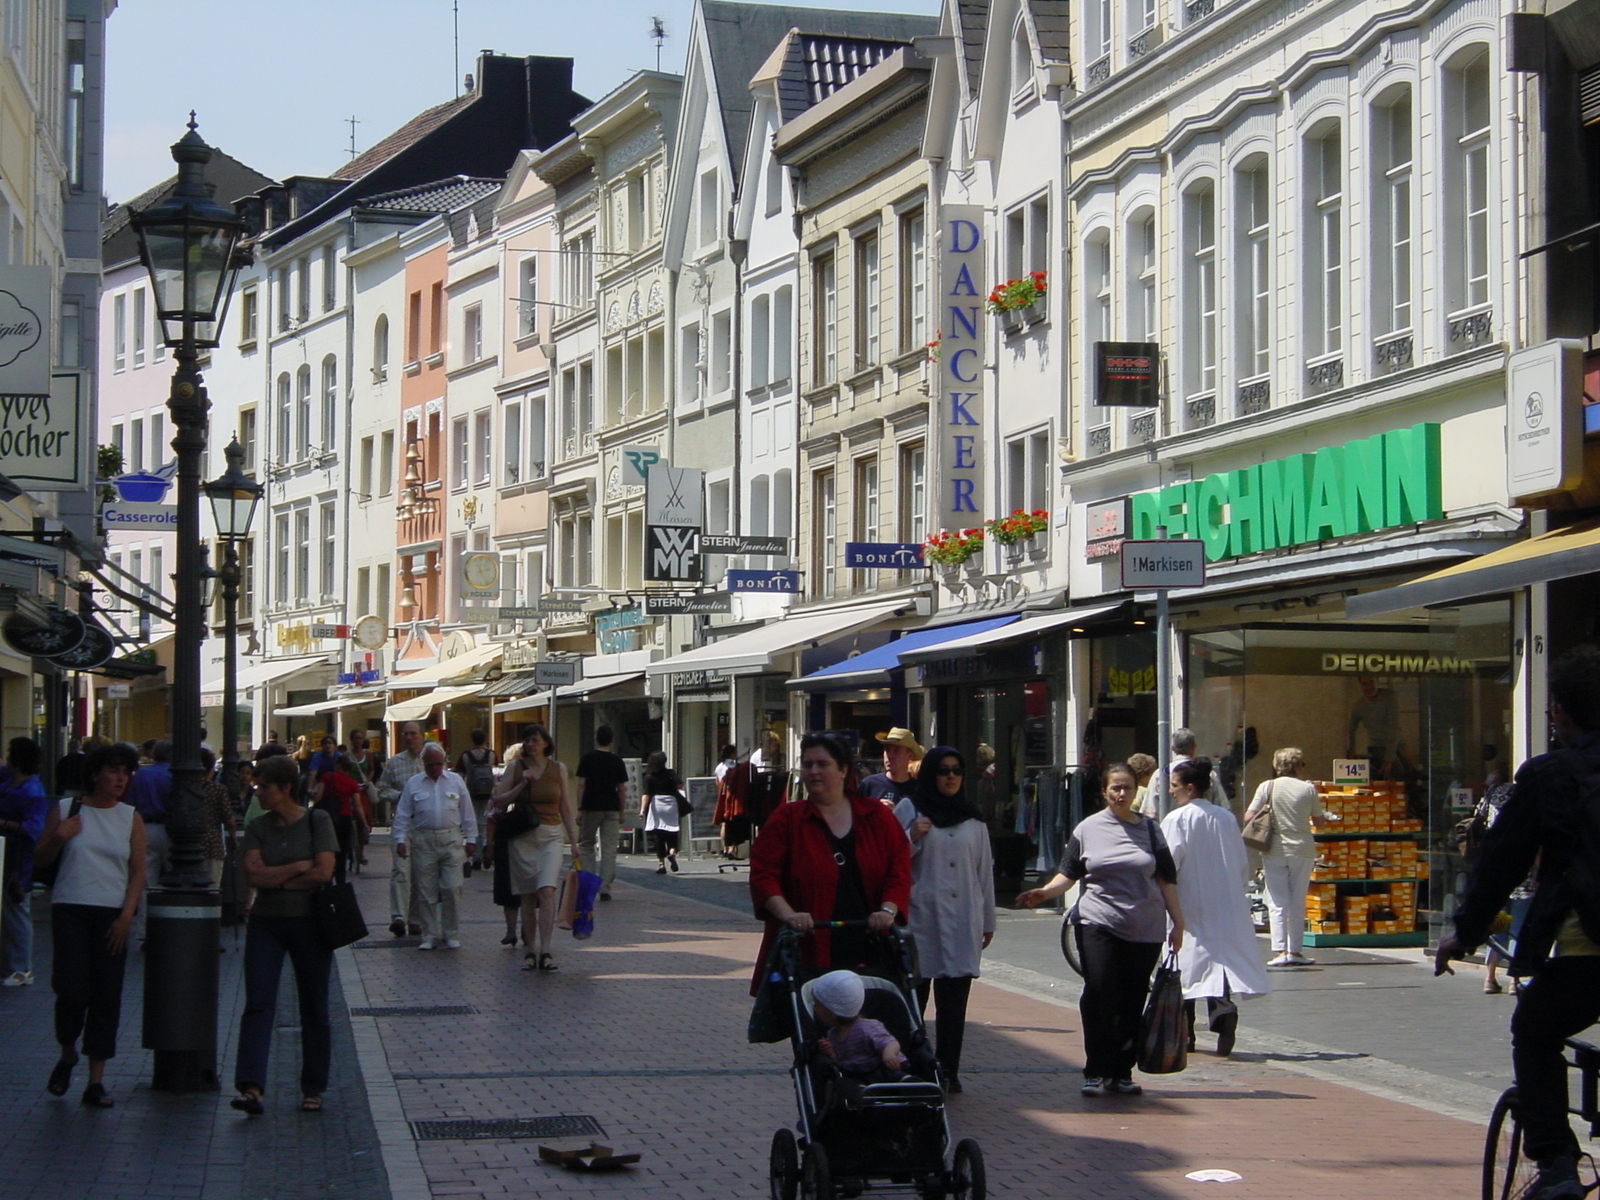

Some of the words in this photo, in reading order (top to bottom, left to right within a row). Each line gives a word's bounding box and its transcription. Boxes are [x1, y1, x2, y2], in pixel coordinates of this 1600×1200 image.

[948, 219, 981, 513] DANCKER
[0, 423, 71, 459] ocher
[1132, 421, 1444, 562] DEICHMANN
[104, 509, 178, 524] Casserole
[701, 536, 741, 547] STERN
[736, 541, 785, 553] Juwelier
[854, 545, 917, 566] BONITA
[736, 571, 792, 591] BONITA
[501, 609, 526, 617] Street
[540, 601, 566, 609] Street
[649, 598, 686, 608] STERN
[682, 601, 728, 613] Juwelier
[1321, 653, 1476, 674] DEICHMANN
